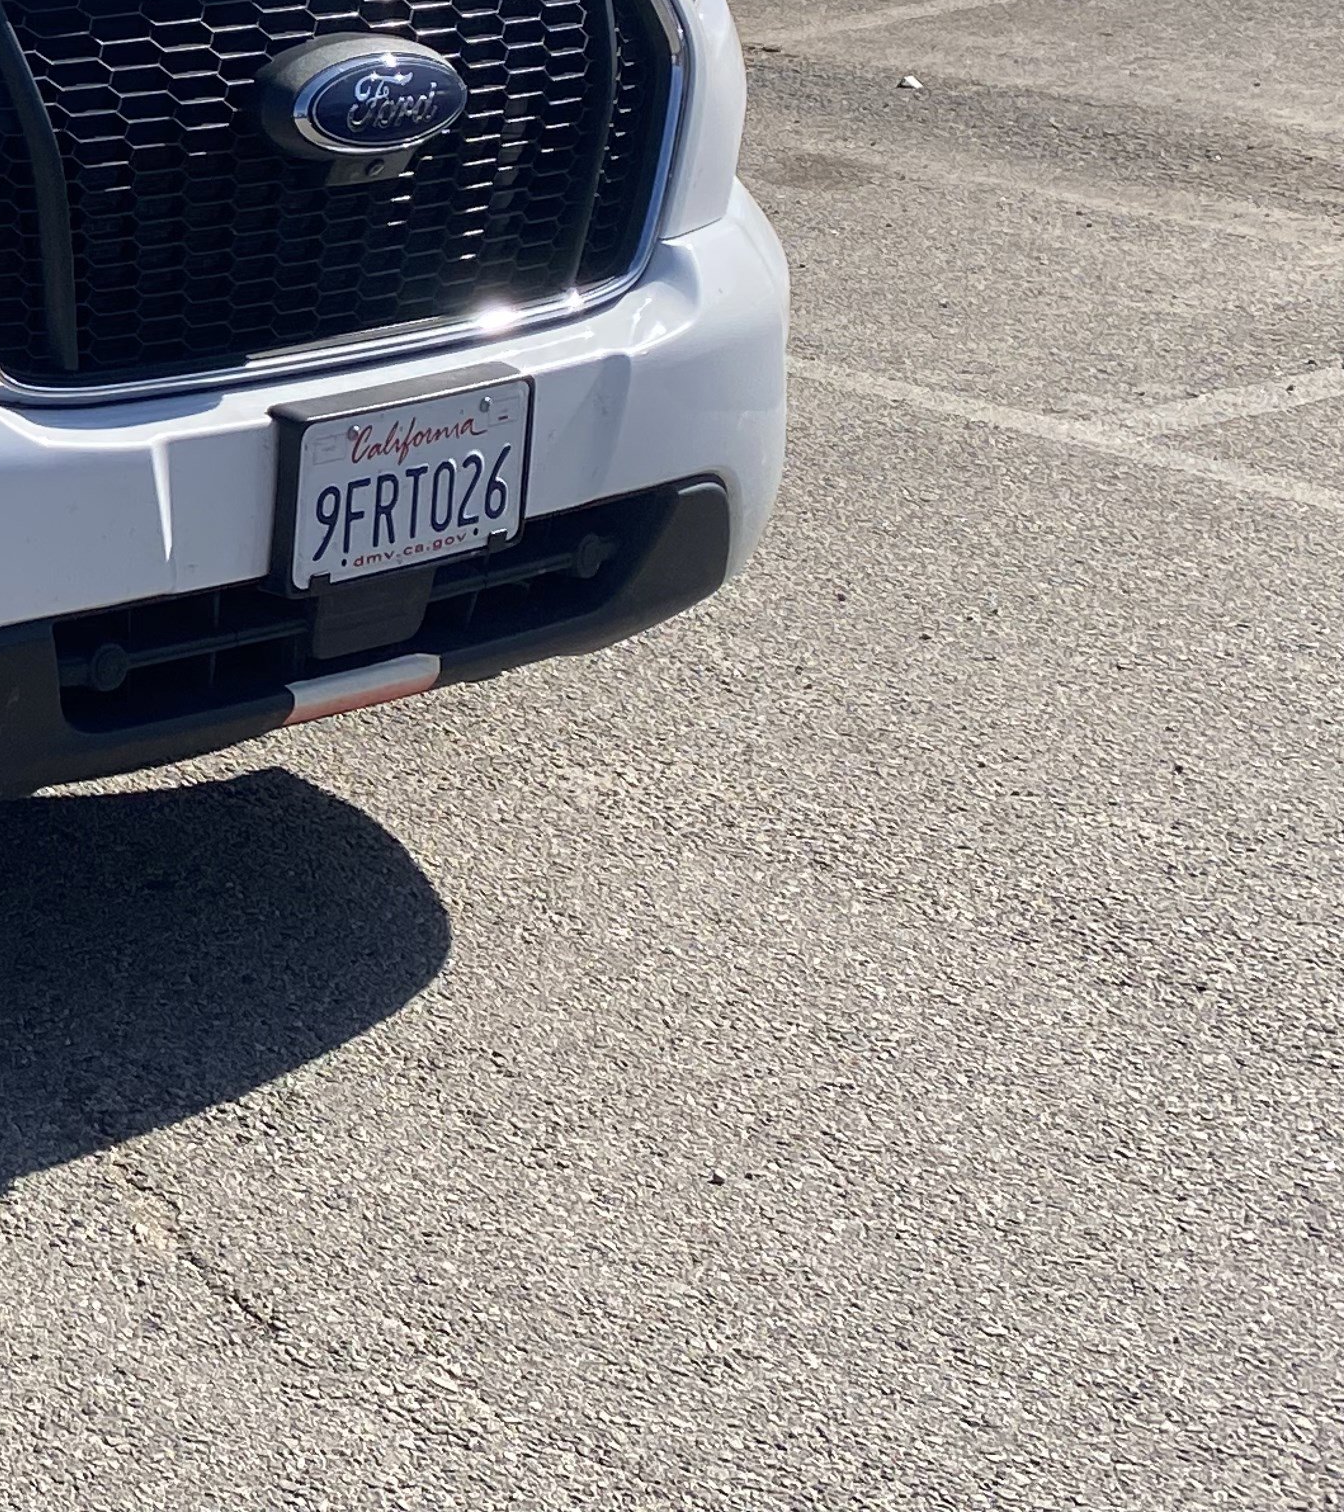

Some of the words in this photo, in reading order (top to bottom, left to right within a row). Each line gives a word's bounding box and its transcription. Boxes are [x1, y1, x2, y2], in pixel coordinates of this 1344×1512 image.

[347, 71, 439, 133] Ford
[350, 417, 488, 465] California
[312, 442, 512, 562] 9FRT026
[352, 532, 468, 568] dmv.ca.gov
